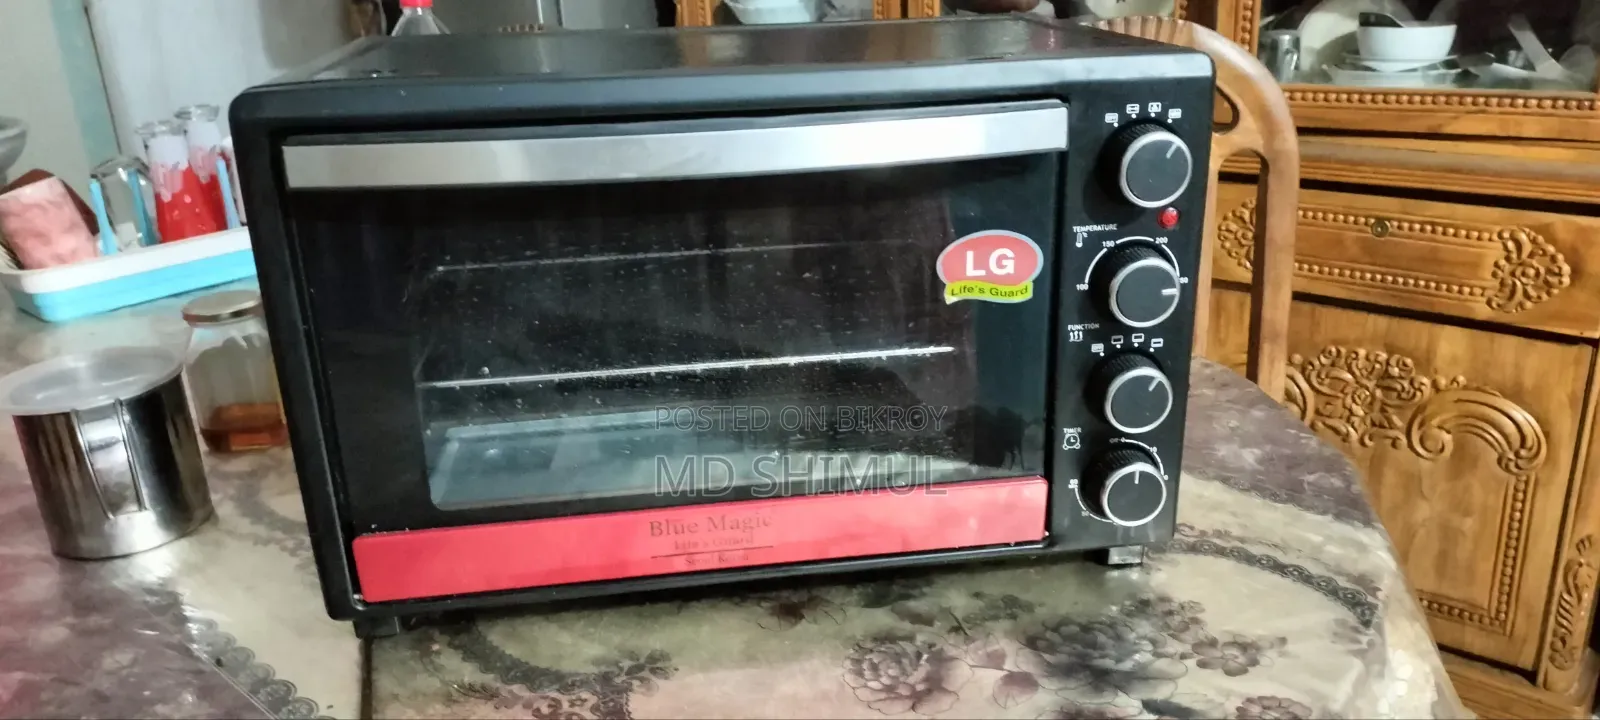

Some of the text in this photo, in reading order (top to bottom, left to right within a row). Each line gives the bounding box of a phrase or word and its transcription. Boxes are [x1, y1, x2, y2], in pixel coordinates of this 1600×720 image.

[1073, 224, 1117, 233] TEMPERATURE
[966, 248, 1015, 276] LG
[989, 285, 1028, 297] Guard
[1067, 323, 1100, 331] FUNCTION
[649, 514, 771, 537] Blue Magic
